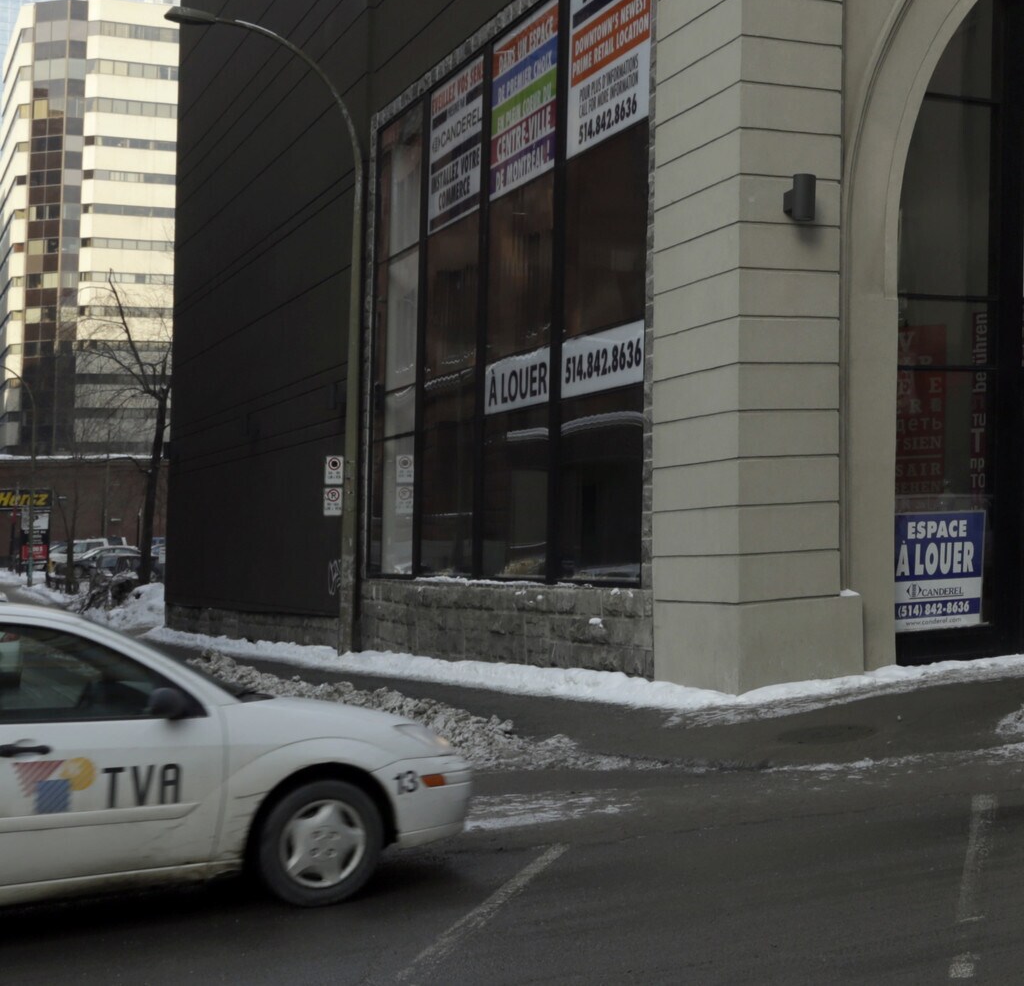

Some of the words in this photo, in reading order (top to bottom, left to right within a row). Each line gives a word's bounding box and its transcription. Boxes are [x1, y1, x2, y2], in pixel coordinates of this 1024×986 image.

[499, 46, 515, 75] DANS
[529, 15, 553, 53] ESPACE
[572, 50, 592, 78] PRIME
[594, 36, 614, 64] RETAIL
[616, 12, 649, 50] LOCATION
[575, 12, 618, 55] DOWNTOWN'S
[457, 71, 468, 96] VOS
[497, 84, 505, 106] DE
[506, 66, 532, 100] PREMIER
[533, 50, 552, 79] CHOIX
[441, 106, 483, 147] CANDEREL
[496, 105, 551, 162] CENTRE-VILLE
[578, 93, 637, 145] 514.842.8636
[431, 161, 459, 194] INSTALLEZ
[461, 148, 479, 175] VOTRE
[495, 167, 504, 193] DE
[506, 144, 544, 185] MONTRÉAL
[439, 175, 470, 211] COMMERCE
[565, 338, 642, 384] 514.842.8636
[488, 369, 497, 406] À
[501, 362, 547, 404] LOUER
[907, 519, 967, 539] ESPACE
[896, 540, 910, 576] À
[914, 541, 974, 575] LOUER
[898, 604, 922, 618] (514)
[924, 600, 970, 615] 842-8636
[921, 586, 964, 597] CANDEREL
[905, 617, 962, 626] www.canderel.com
[102, 763, 182, 808] TVA
[394, 770, 418, 794] 13
